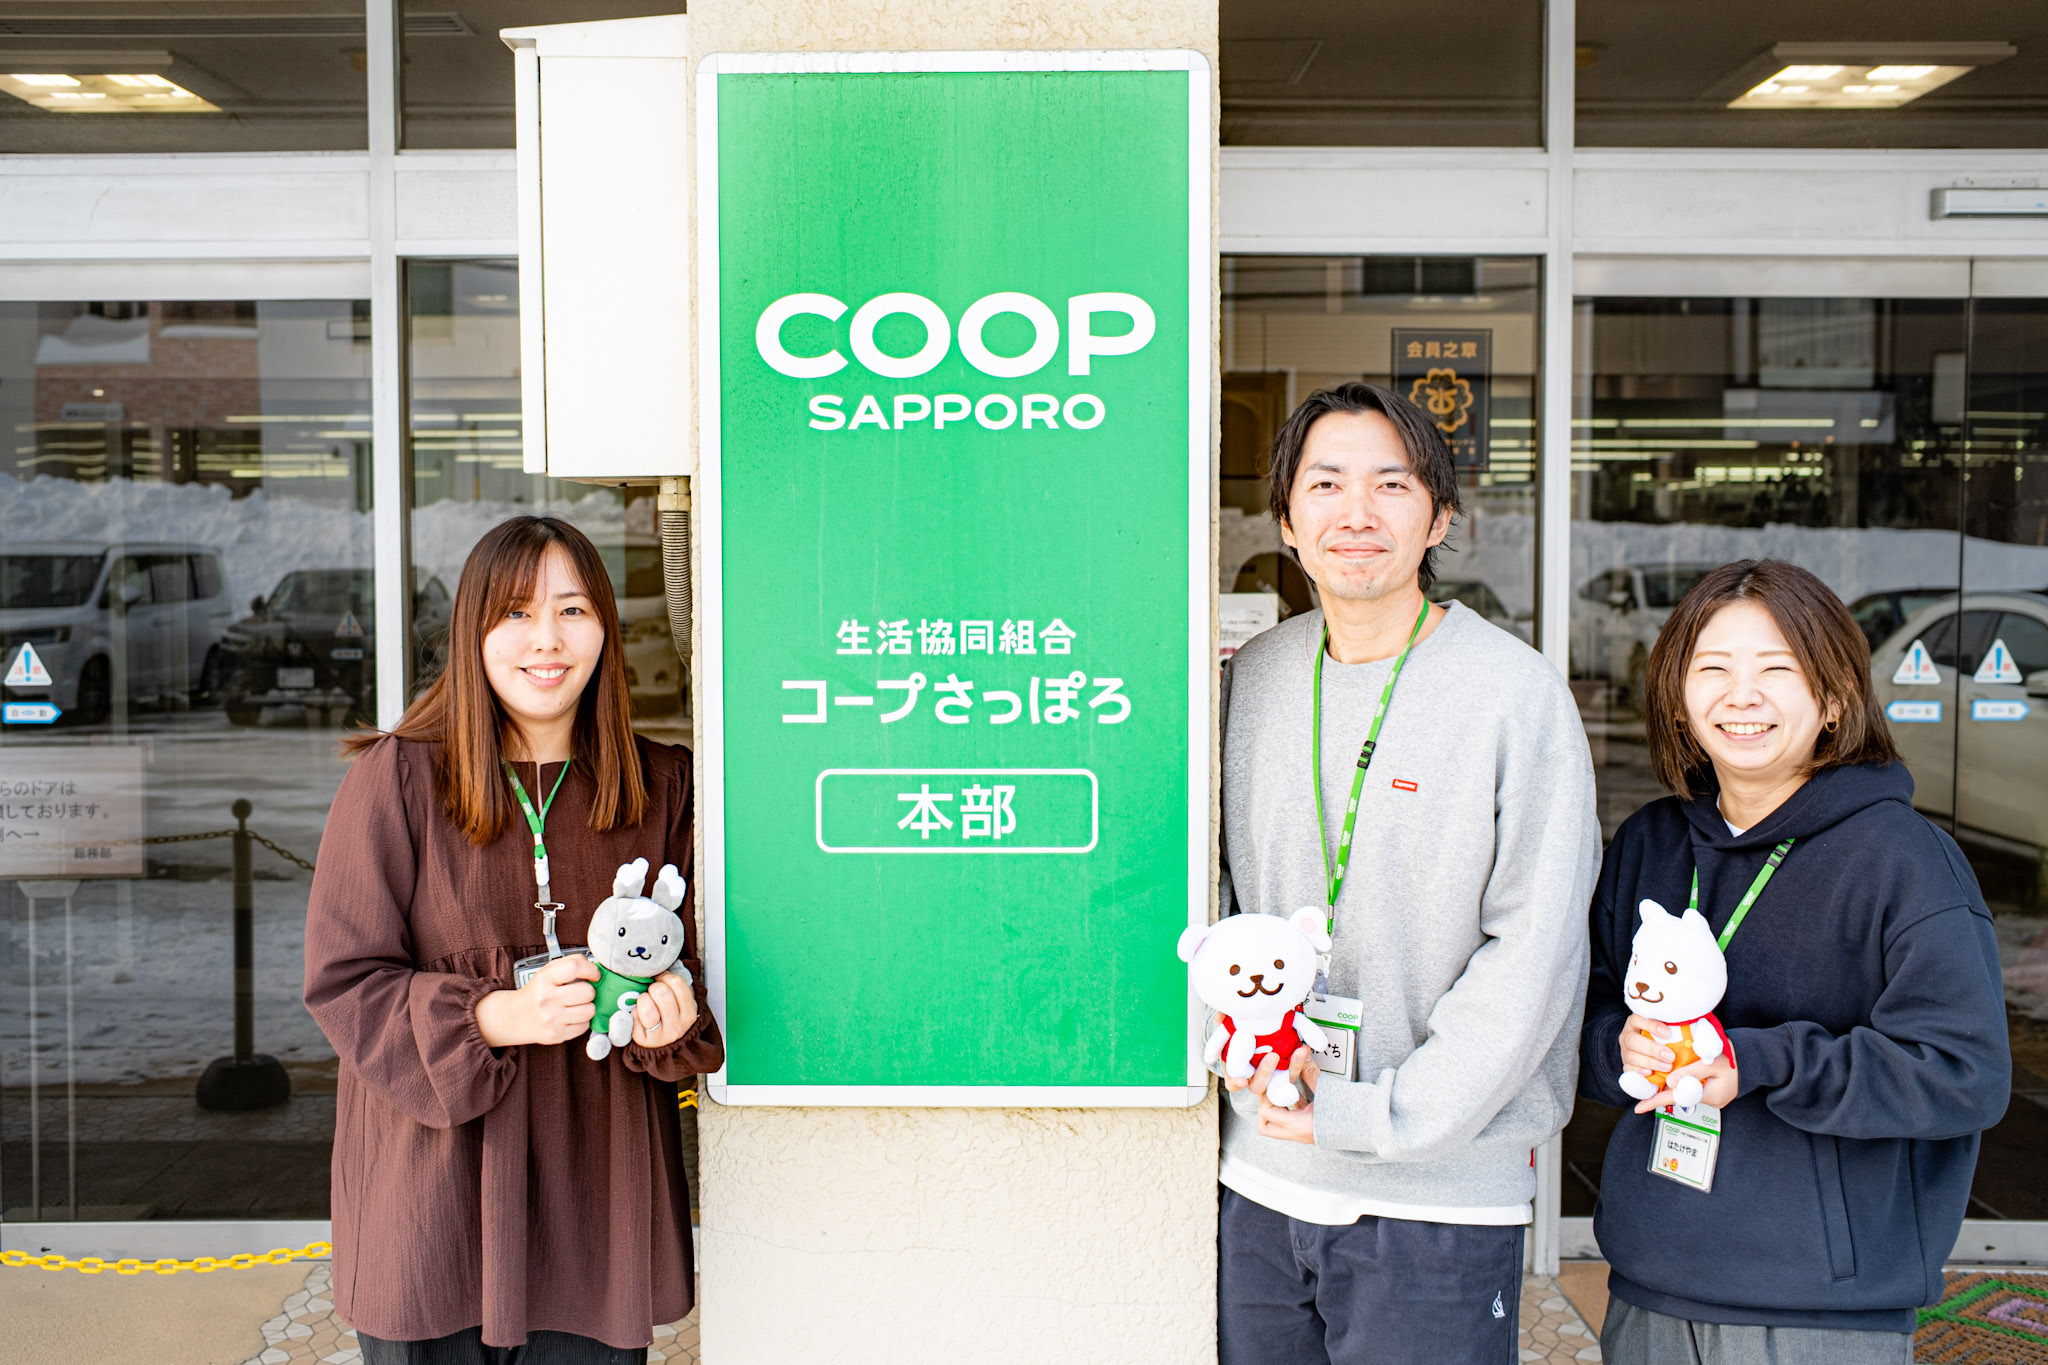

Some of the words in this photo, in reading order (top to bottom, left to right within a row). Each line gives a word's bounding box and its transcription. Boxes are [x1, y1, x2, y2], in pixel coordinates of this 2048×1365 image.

[755, 291, 1156, 379] COOP
[808, 393, 1106, 431] SAPPORO
[836, 618, 1077, 655] 生活協同組合
[782, 671, 1132, 724] コープさっぽろ
[897, 784, 1017, 839] 本部
[1337, 1012, 1359, 1020] COOP
[1667, 1140, 1697, 1158] はたけやま
